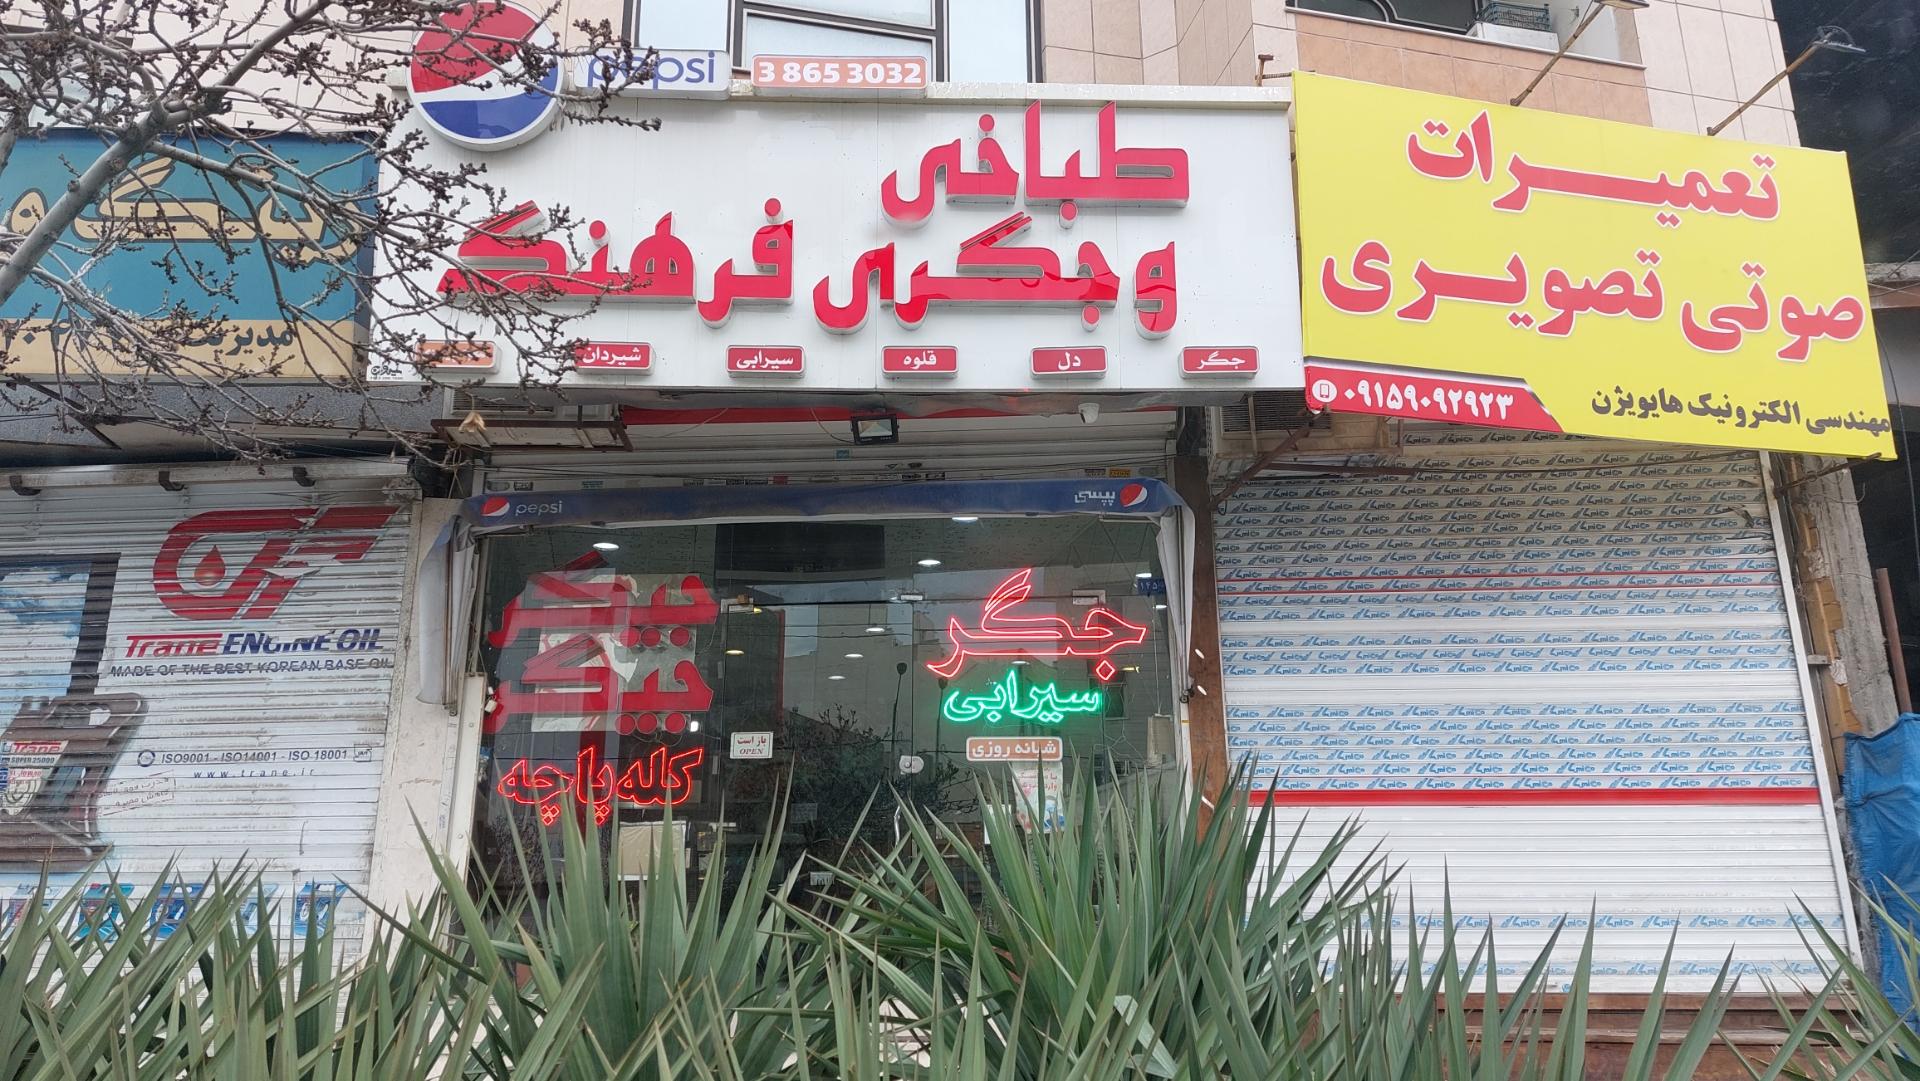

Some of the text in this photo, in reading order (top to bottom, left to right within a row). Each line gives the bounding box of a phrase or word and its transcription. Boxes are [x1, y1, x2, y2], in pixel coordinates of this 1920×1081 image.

[881, 99, 1189, 226] طباخی
[1406, 109, 1780, 228] تعمیرات
[436, 198, 795, 324] فرهنگ
[813, 212, 1121, 332] جگری
[1321, 240, 1864, 362] صوتی تصویری
[582, 346, 642, 365] شیردان
[737, 348, 794, 369] سیرابی
[903, 352, 938, 369] قلوه
[1057, 352, 1081, 370] دل
[1197, 353, 1246, 369] جگر
[1591, 386, 1890, 436] مهندسی الکترونیک هایویژن
[515, 500, 563, 516] pepsi
[927, 568, 1147, 680] جگر
[126, 633, 223, 657] Trane
[336, 629, 385, 650] OIL
[110, 658, 394, 677] MADE OF THE BEST KOREAN BASE OIL
[944, 670, 1100, 722] سیرابی
[161, 753, 210, 764] ISO9001
[972, 740, 1056, 758] شبانه روزی
